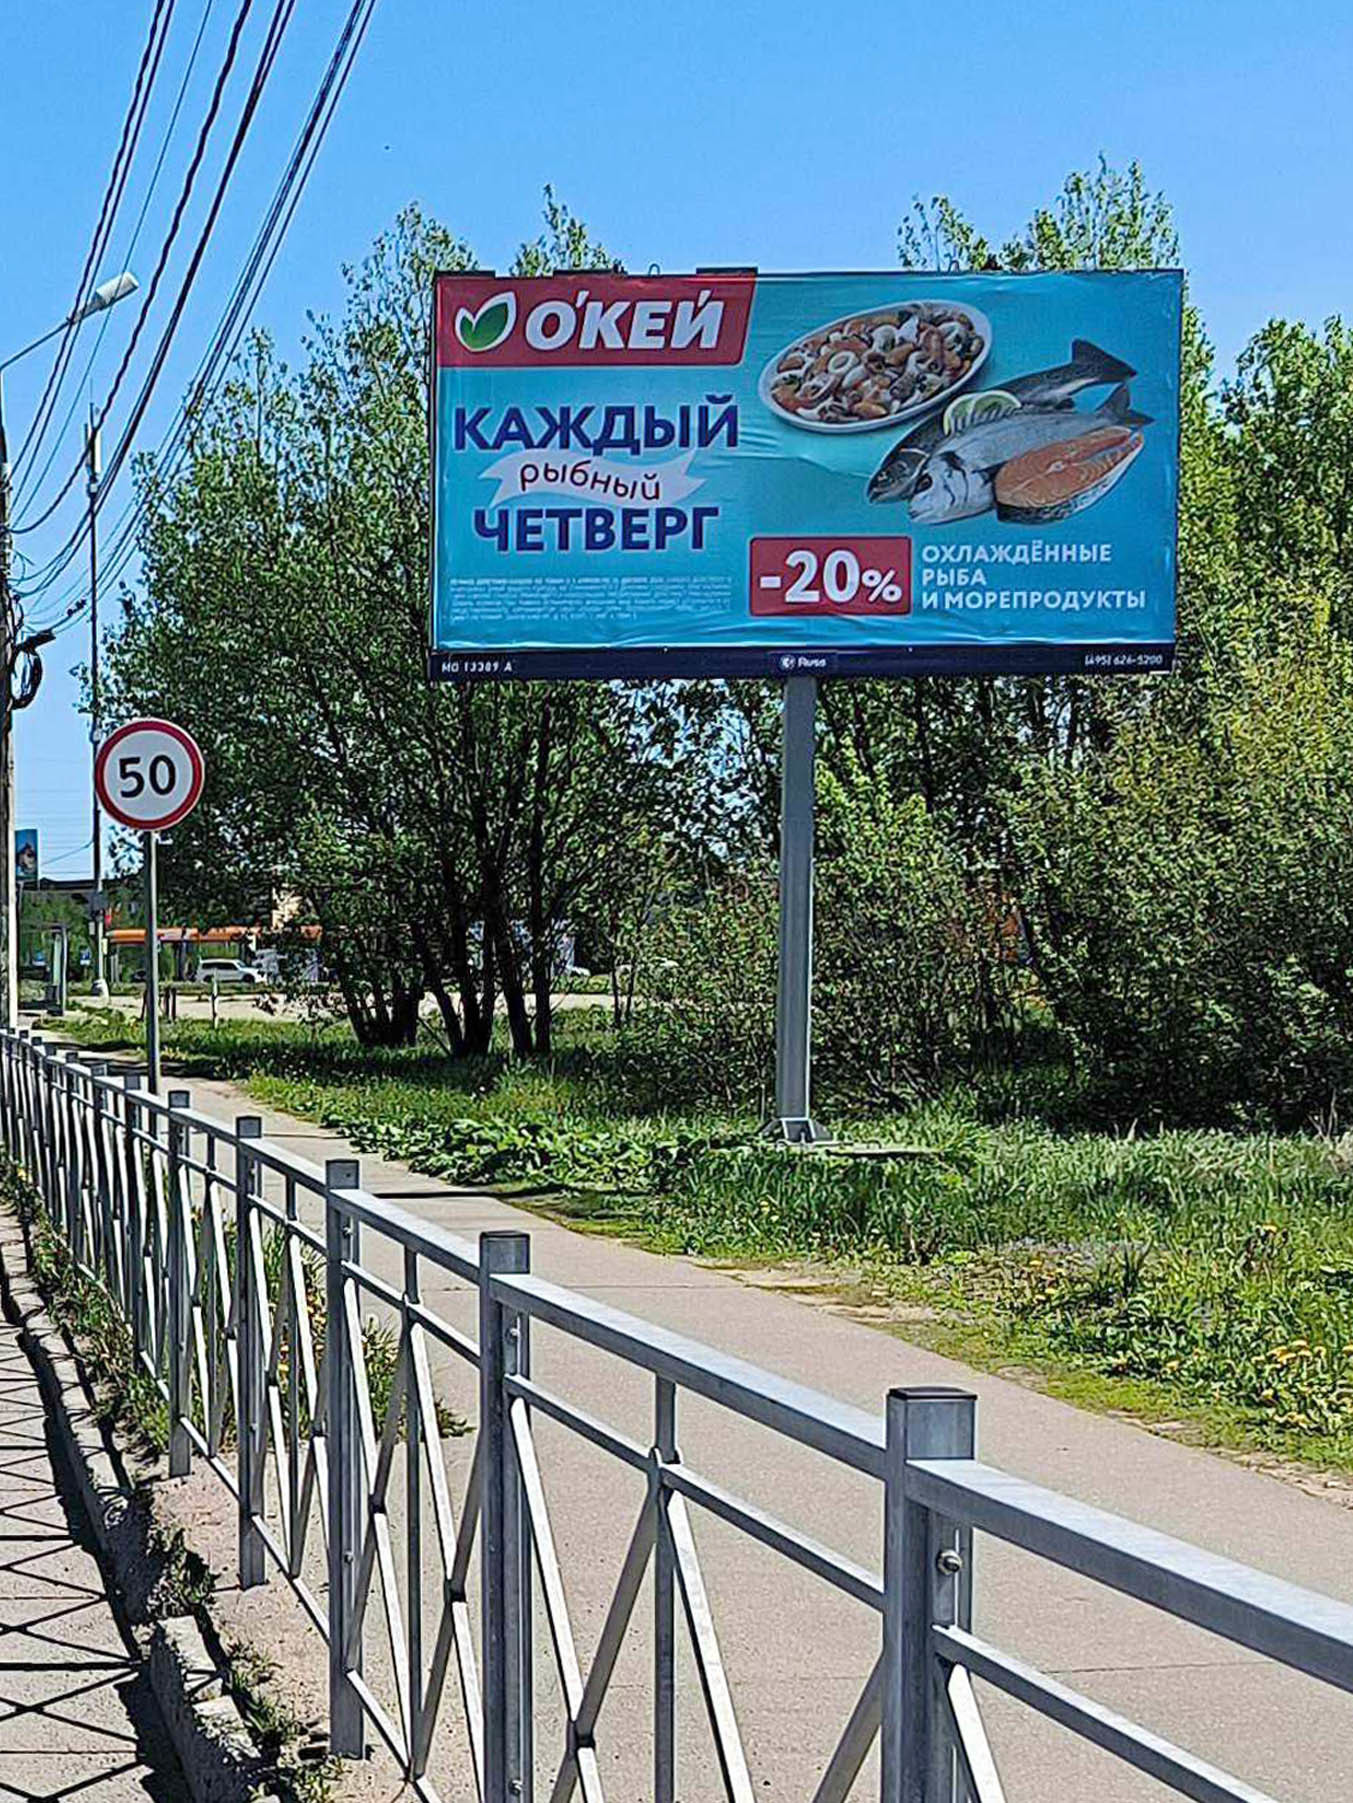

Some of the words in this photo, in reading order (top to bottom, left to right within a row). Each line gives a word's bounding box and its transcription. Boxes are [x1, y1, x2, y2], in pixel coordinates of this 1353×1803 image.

[453, 394, 740, 456] КАЖДЫЙ
[520, 459, 661, 500] рыбный
[473, 506, 720, 552] ЧЕТВЕРГ
[922, 543, 1112, 565] ОХЛАЖДЁННЫЕ
[759, 549, 903, 605] -20%
[922, 569, 987, 587] РЫБА
[922, 591, 939, 610] И
[944, 590, 1146, 612] МОРЕПРОДУКТЫ
[119, 755, 176, 798] 50
